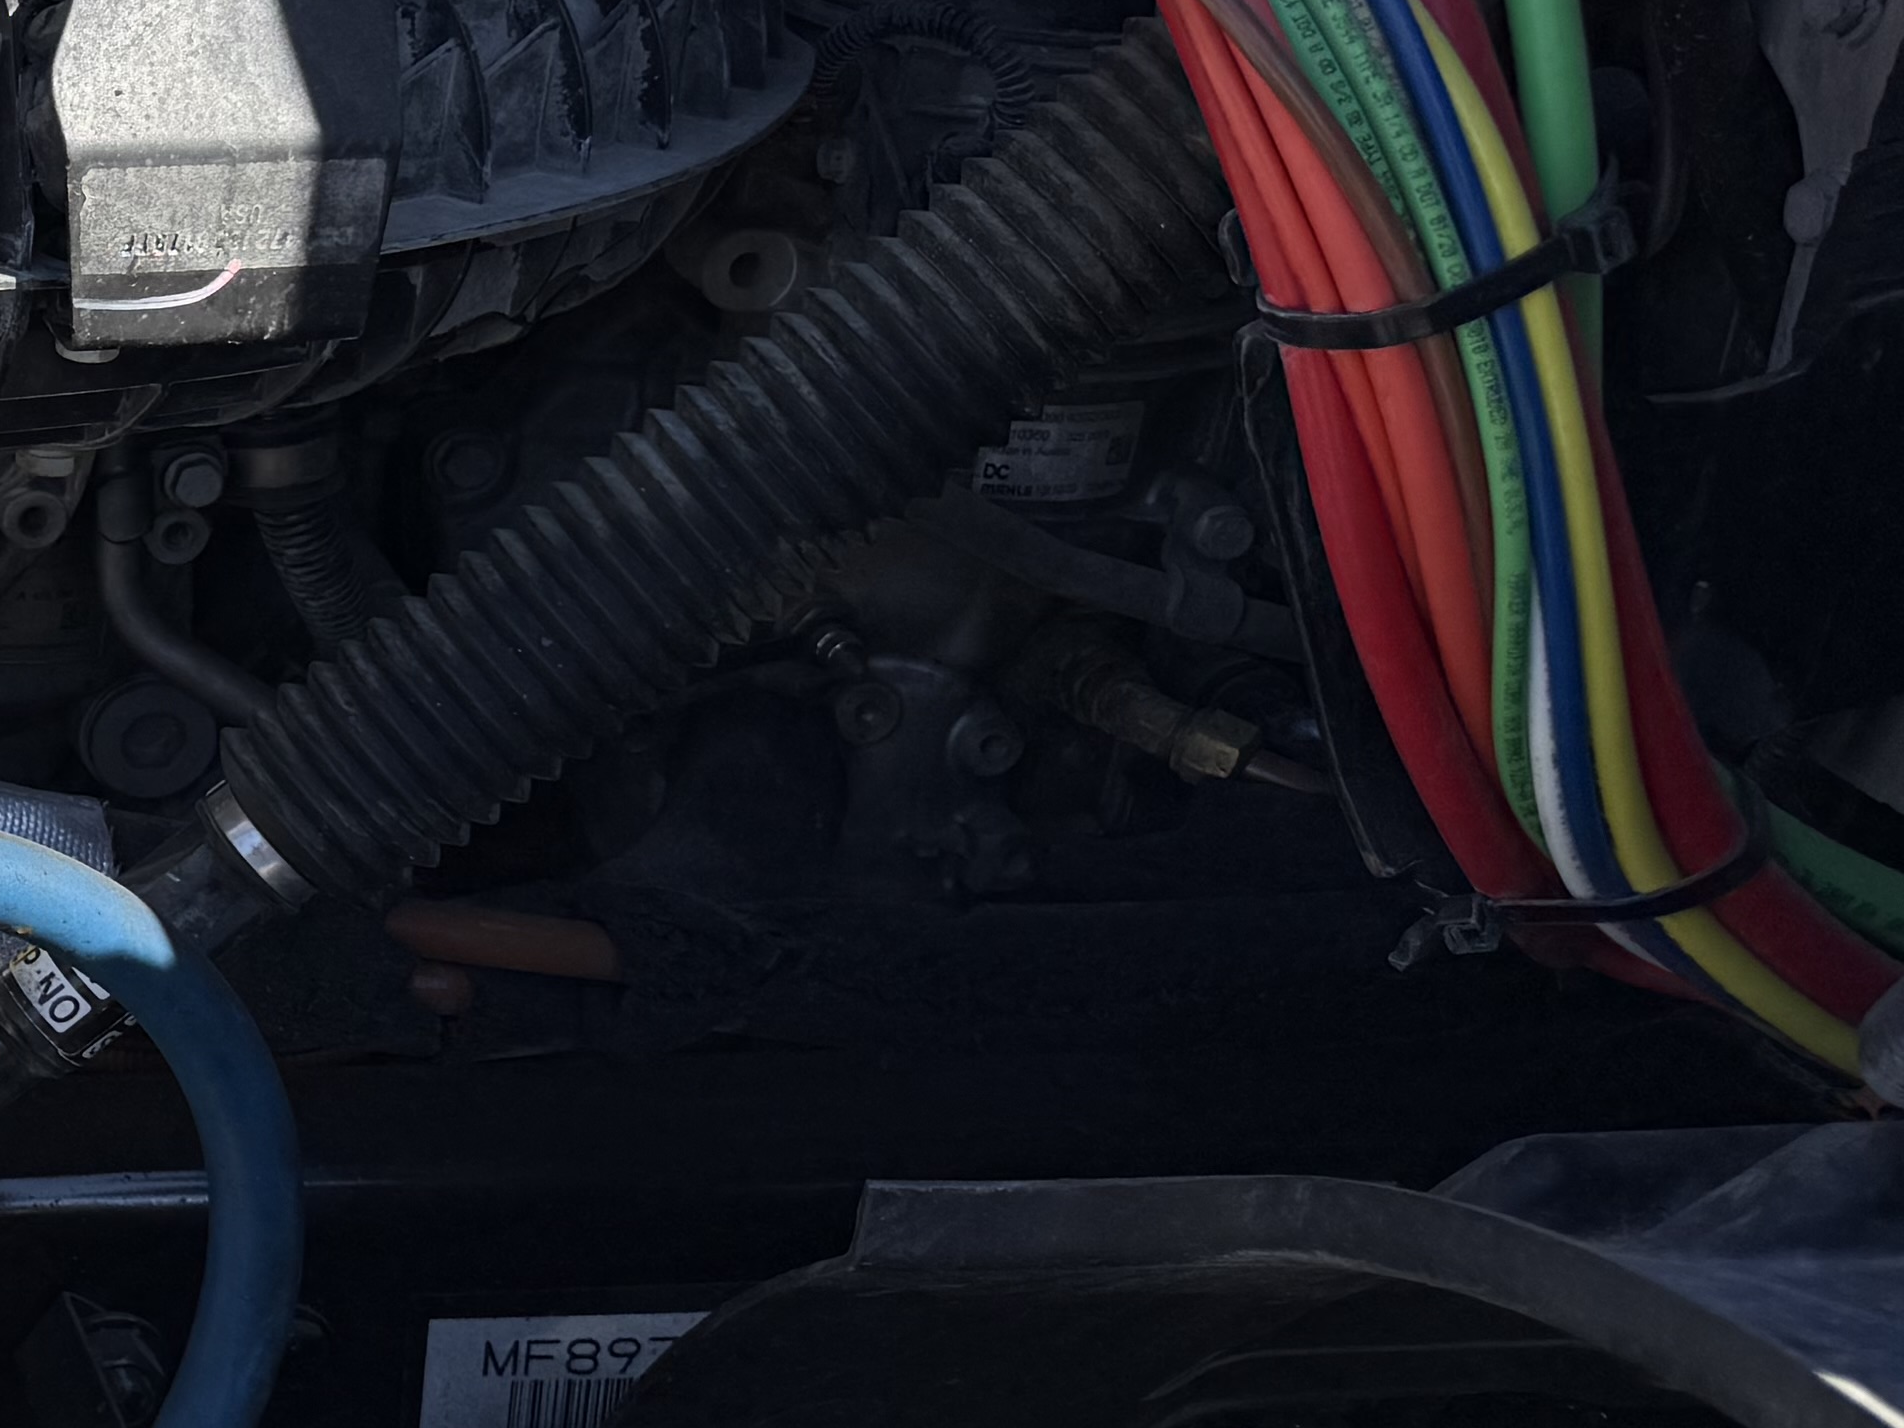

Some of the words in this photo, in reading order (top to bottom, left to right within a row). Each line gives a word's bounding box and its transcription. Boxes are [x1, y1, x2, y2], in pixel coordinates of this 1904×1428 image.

[1287, 8, 1315, 40] DOT
[1313, 52, 1337, 77] OD
[1350, 49, 1383, 87] TYPE
[1380, 111, 1406, 142] 1/4
[1412, 182, 1439, 216] DOT
[1352, 128, 1384, 167] TYPE
[983, 463, 1010, 480] DC
